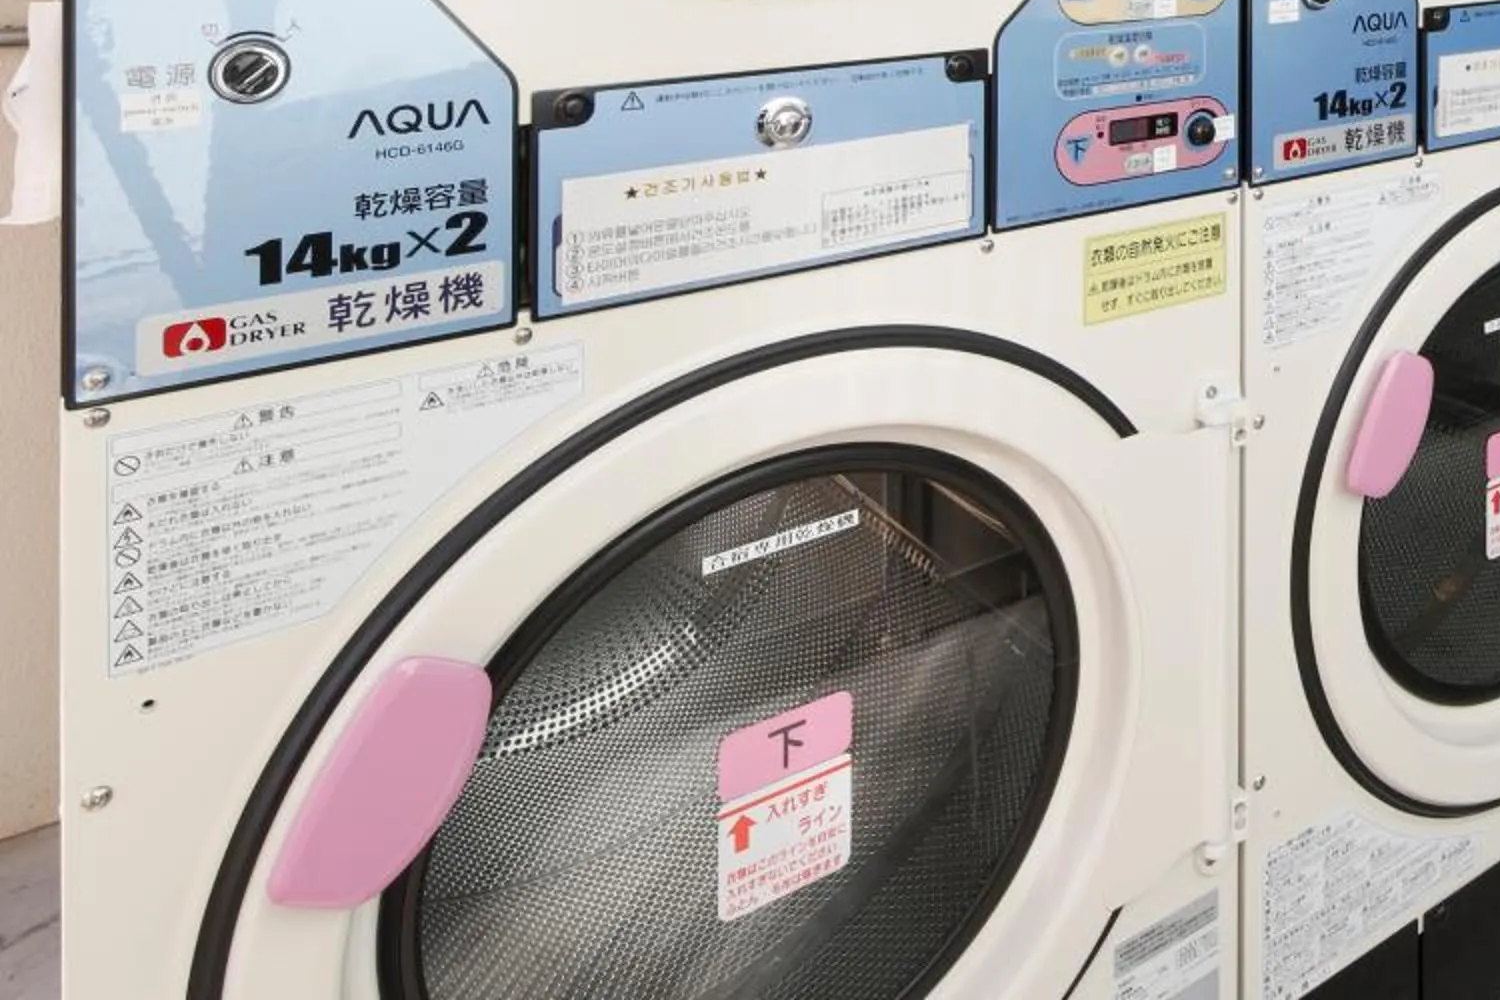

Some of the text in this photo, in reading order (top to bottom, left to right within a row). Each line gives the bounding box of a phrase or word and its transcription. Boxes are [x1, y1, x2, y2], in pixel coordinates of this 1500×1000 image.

[1353, 11, 1407, 33] AQUA
[125, 63, 196, 88] 電源
[348, 99, 490, 138] AQUA
[375, 140, 465, 160] HCD-6146G
[1067, 137, 1088, 162] 下
[1344, 120, 1405, 152] 乾燥機
[355, 179, 488, 220] 乾燥容量
[328, 272, 484, 332] 乾燥機
[229, 311, 278, 330] GAS
[230, 322, 305, 346] DRYER
[768, 719, 806, 768] 下
[766, 781, 828, 822] 入れすぎ
[799, 806, 843, 834] ライン
